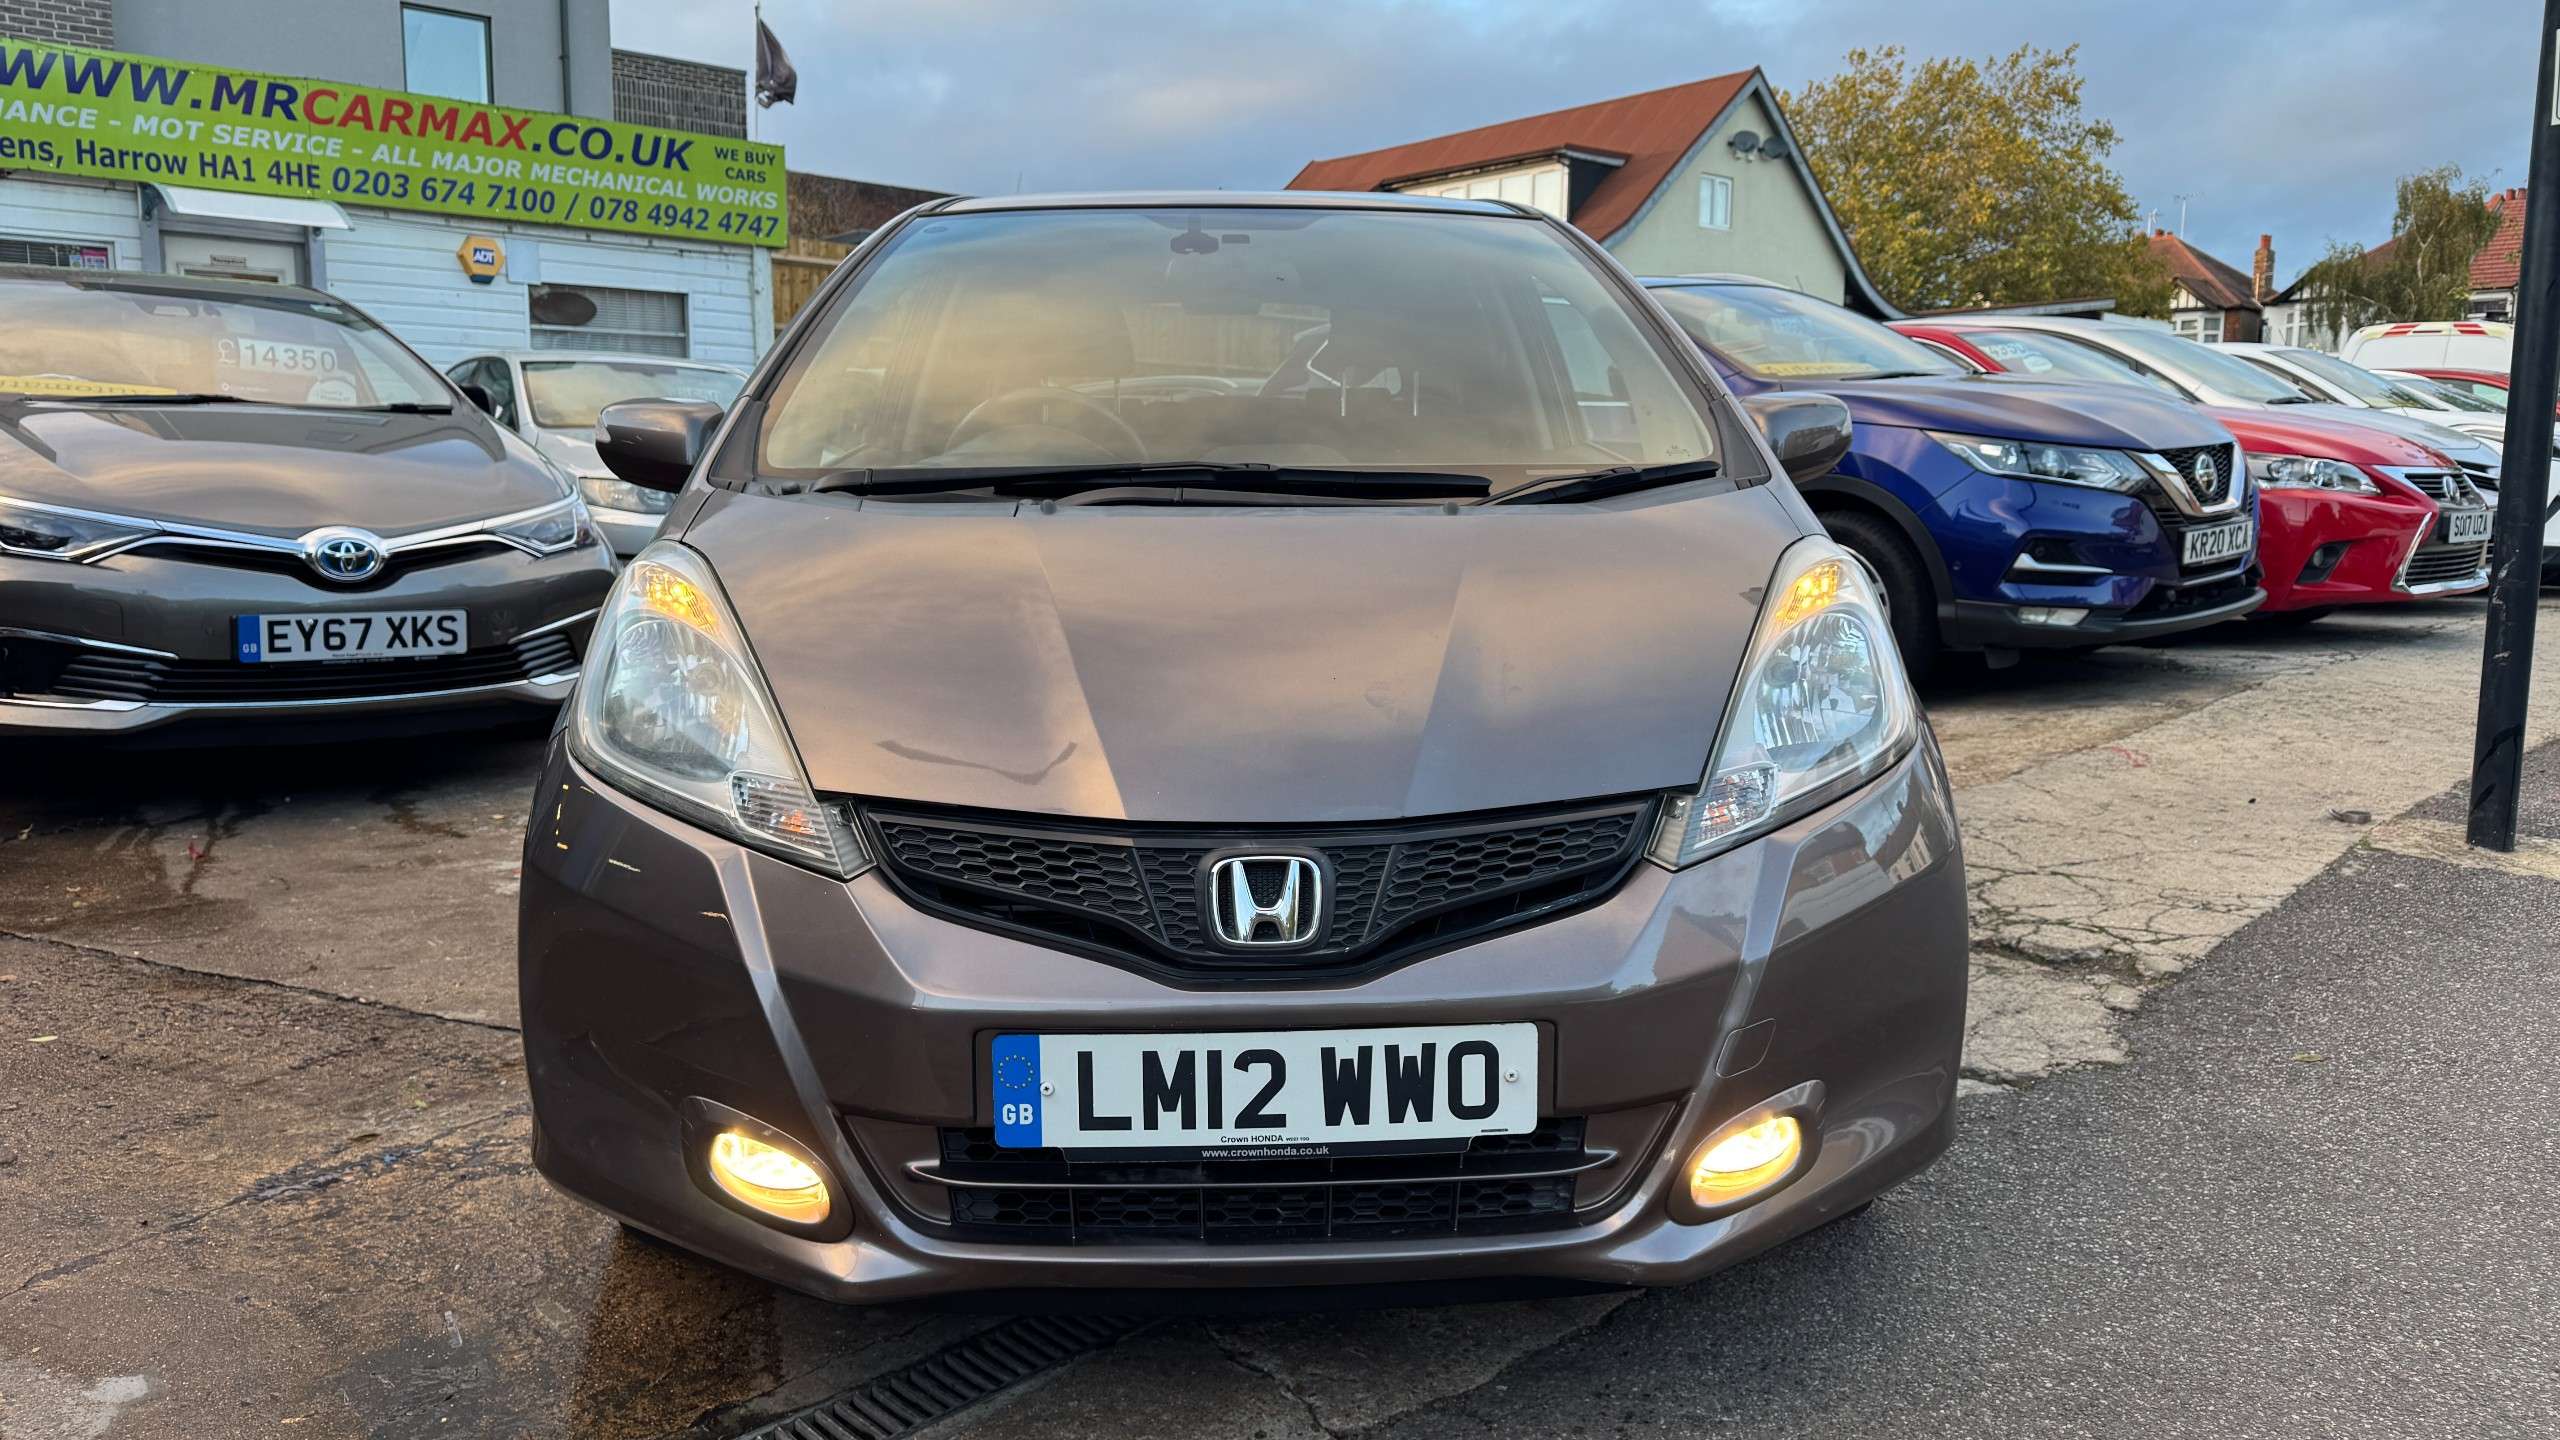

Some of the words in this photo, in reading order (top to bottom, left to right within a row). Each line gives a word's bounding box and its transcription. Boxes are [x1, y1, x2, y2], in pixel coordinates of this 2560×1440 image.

[0, 98, 98, 129] ANCE
[133, 115, 204, 141] MOT
[212, 123, 344, 158] SERVICE
[371, 143, 422, 168] ALL
[431, 151, 522, 179] MAJOR
[530, 163, 688, 199] MECHANICAL
[696, 183, 779, 211] WORKS
[715, 147, 738, 162] WE
[744, 152, 776, 166] BUY
[725, 167, 767, 183] CARS
[75, 138, 188, 175] Harrow
[199, 152, 256, 182] HA1
[267, 160, 321, 190] 4HE
[332, 166, 410, 199] 0203
[420, 176, 475, 206] 674
[486, 184, 556, 214] 7100
[589, 196, 639, 224] 078
[647, 203, 710, 232] 4942
[718, 211, 780, 239] 4747
[474, 249, 494, 264] ADT
[2190, 529, 2225, 560] KR20
[2227, 524, 2249, 552] XCA
[267, 618, 373, 653] EY67
[386, 615, 458, 649] XKS
[242, 643, 257, 654] GB
[1077, 1048, 1287, 1131] LM12
[1321, 1040, 1501, 1127] WWO
[1002, 1103, 1033, 1125] GB
[1220, 1135, 1249, 1143] Crown
[1251, 1134, 1284, 1143] HONDA
[1202, 1145, 1329, 1158] www.crownhonda.co.uk
